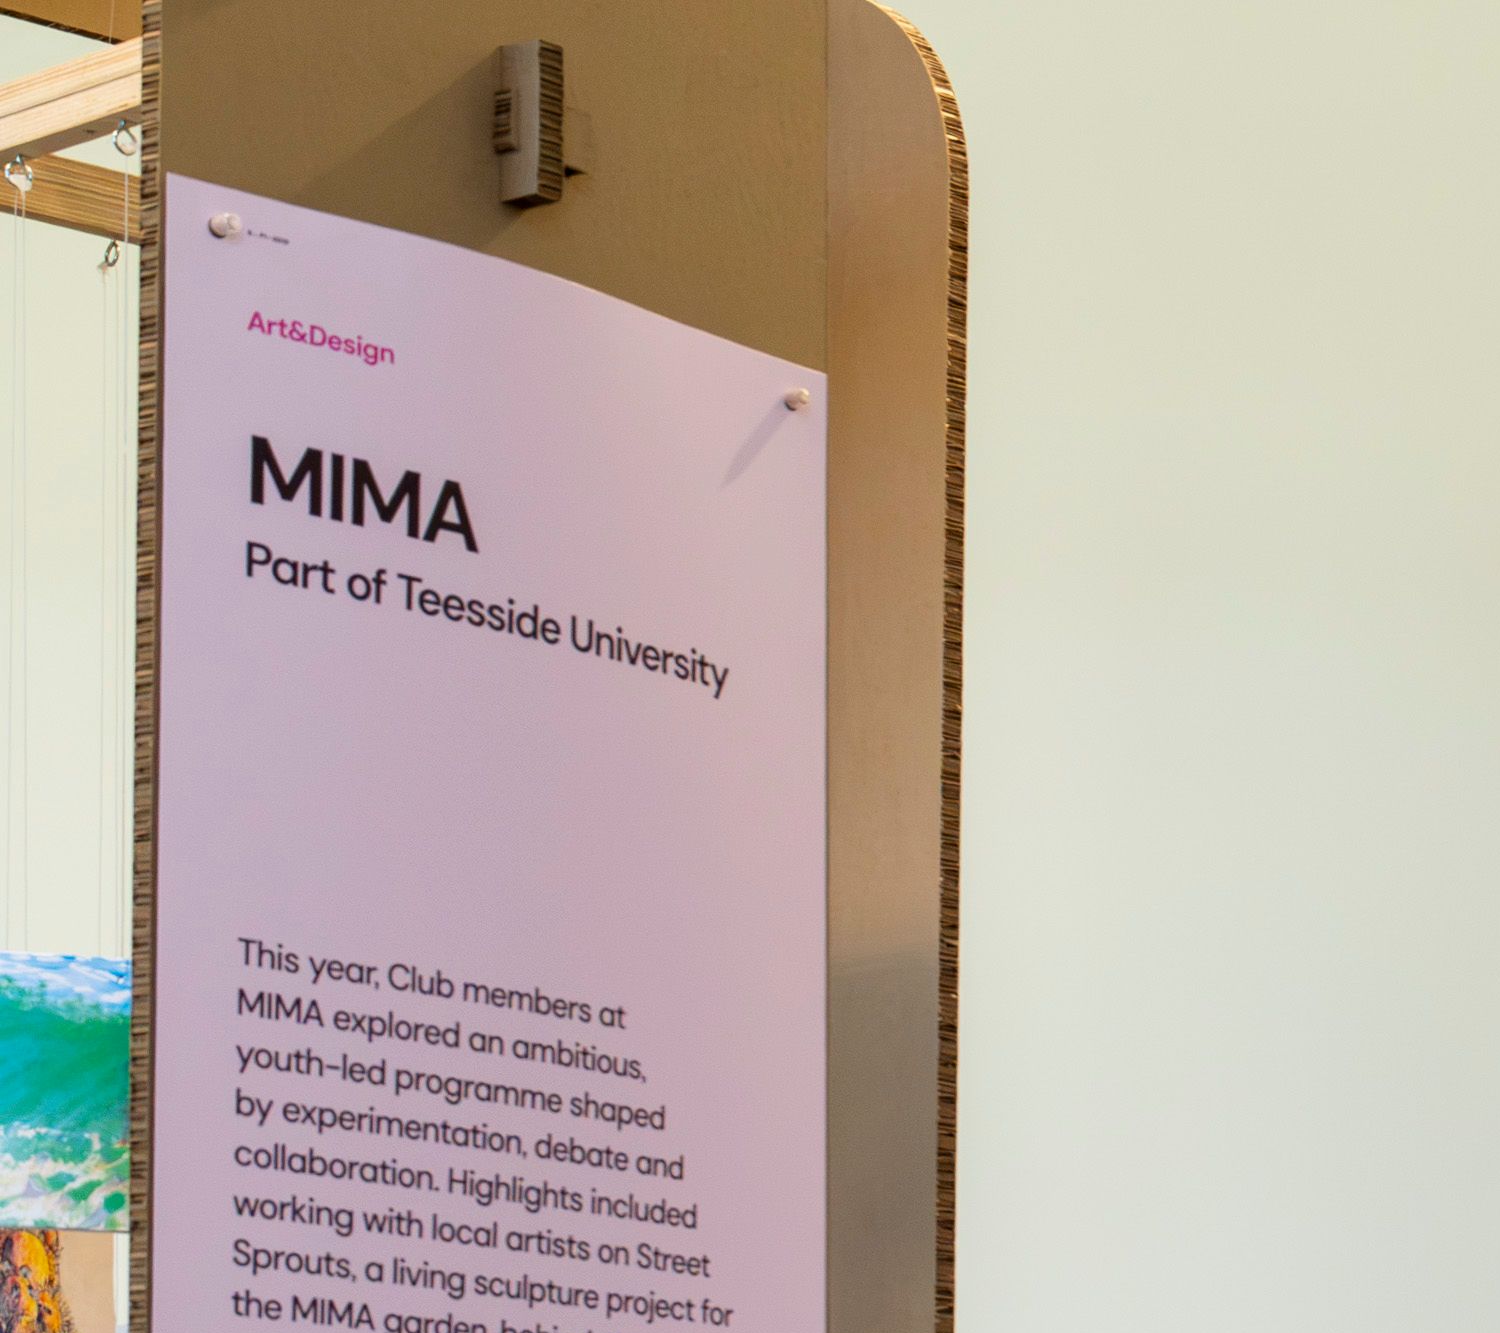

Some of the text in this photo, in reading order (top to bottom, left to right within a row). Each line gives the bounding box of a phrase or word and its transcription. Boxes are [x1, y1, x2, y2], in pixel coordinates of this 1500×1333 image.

[247, 311, 395, 367] Art&Design
[250, 435, 479, 554] MIMA
[246, 540, 729, 698] Part of Teesside University
[237, 937, 627, 1030] This year, Club members at
[237, 987, 646, 1083] MIMA explored an ambitious,
[235, 1044, 666, 1131] youth-led programme shaped
[235, 1087, 684, 1181] by experimentation, debate and
[234, 1143, 698, 1230] collaboration. Highlights included
[233, 1195, 711, 1278] working with local artists on Street
[231, 1289, 283, 1321] the
[291, 1295, 376, 1331] MIMA
[232, 1238, 734, 1327] Sprouts, a living sculpture project for
